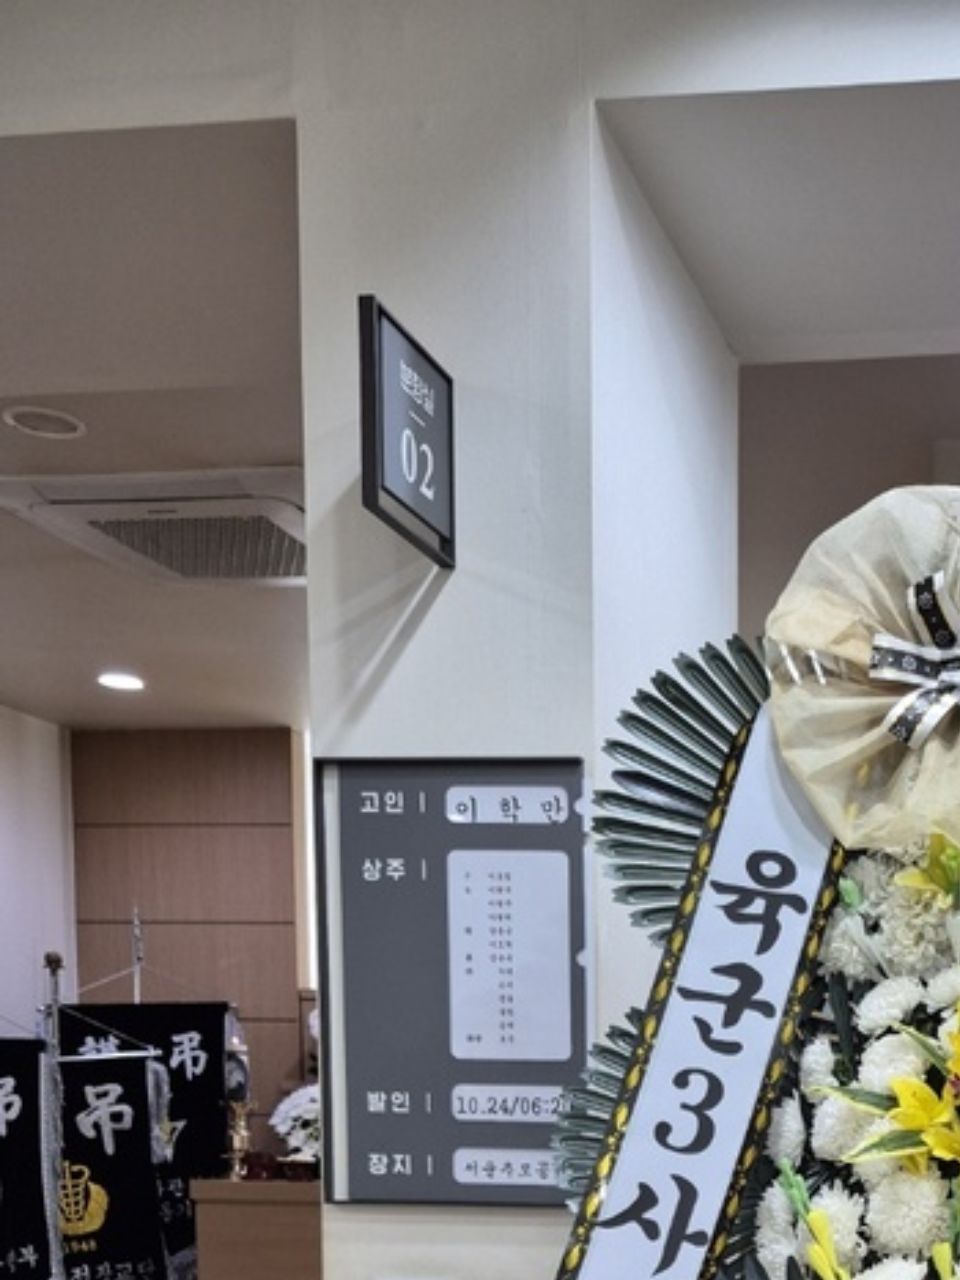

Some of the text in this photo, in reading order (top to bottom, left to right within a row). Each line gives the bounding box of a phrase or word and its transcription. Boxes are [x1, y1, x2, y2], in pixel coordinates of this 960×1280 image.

[401, 427, 434, 500] 02
[360, 791, 404, 813] 고인
[362, 858, 405, 881] 상주
[367, 1091, 409, 1114] 발인
[457, 1096, 562, 1116] 10.24/06:2
[369, 1153, 412, 1176] 장지
[465, 1160, 552, 1180] 서울추모공
